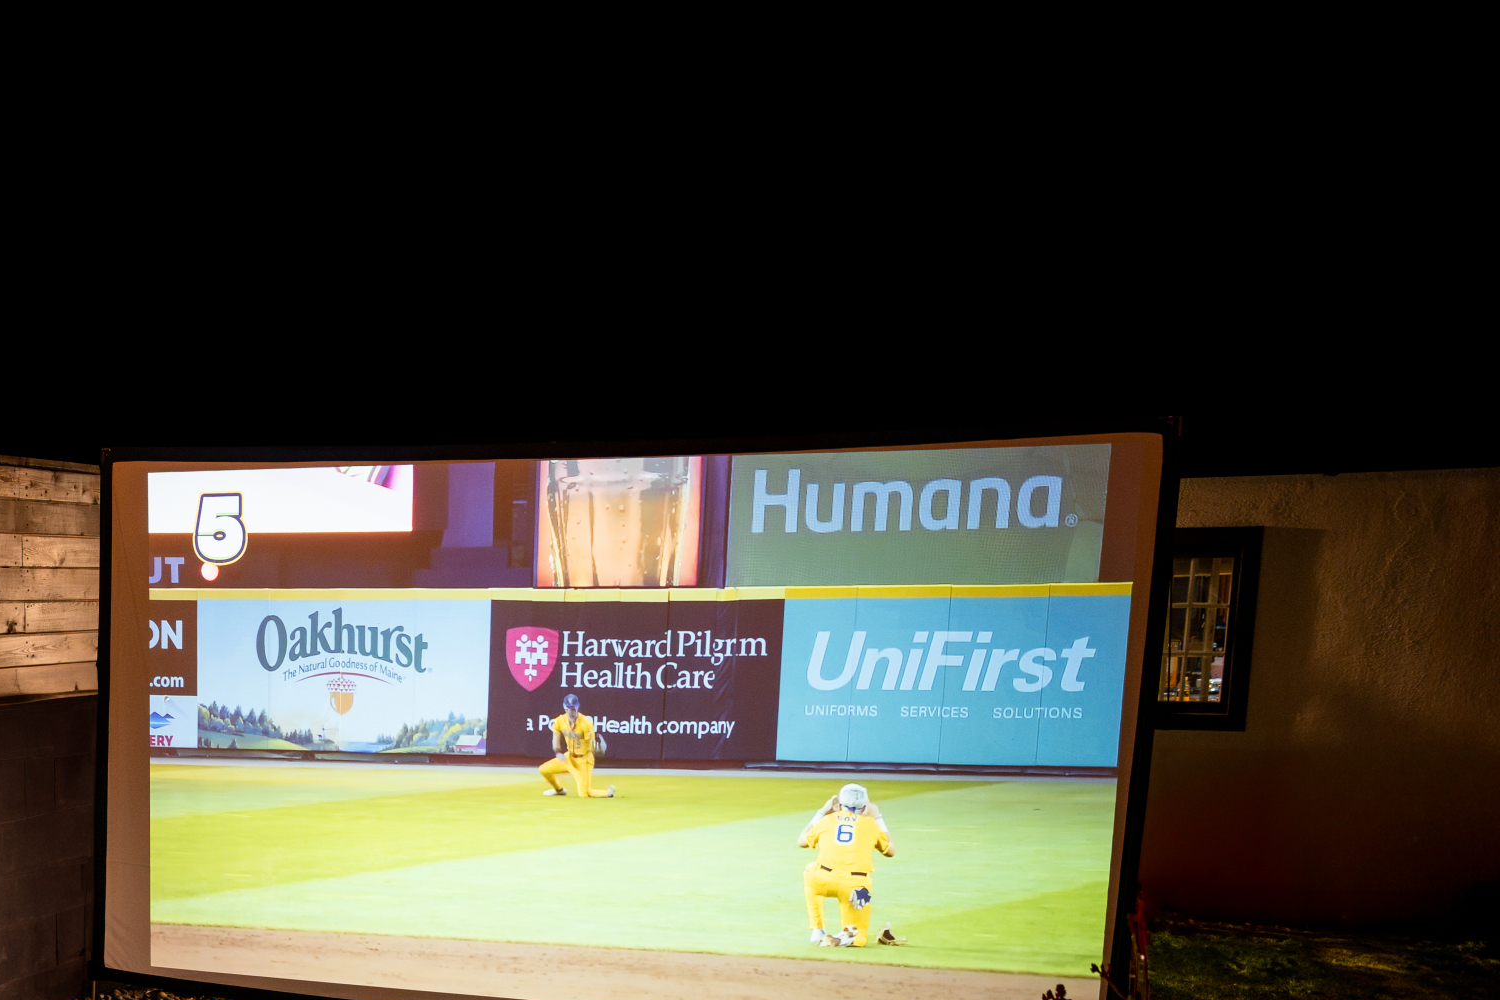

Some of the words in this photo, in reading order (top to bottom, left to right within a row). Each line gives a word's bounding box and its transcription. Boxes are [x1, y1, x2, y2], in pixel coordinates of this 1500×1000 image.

[751, 468, 1063, 533] Humana
[192, 491, 248, 564] 5
[256, 607, 429, 673] Oakhurst
[561, 629, 672, 658] Harvard
[676, 630, 768, 666] Pilgrm
[282, 668, 296, 681] The
[299, 658, 327, 673] Natural
[329, 657, 368, 671] Goodness
[369, 662, 378, 672] of
[380, 664, 403, 683] Maine
[807, 631, 1097, 692] UniFirst
[560, 662, 652, 689] Health
[656, 662, 715, 689] Care
[804, 704, 878, 717] UNIFORMS
[900, 706, 969, 718] SERVICES
[992, 707, 1083, 719] SOLUTIONS
[150, 735, 173, 746] ERY
[526, 718, 534, 731] a
[656, 720, 735, 739] company
[836, 823, 854, 843] 6
